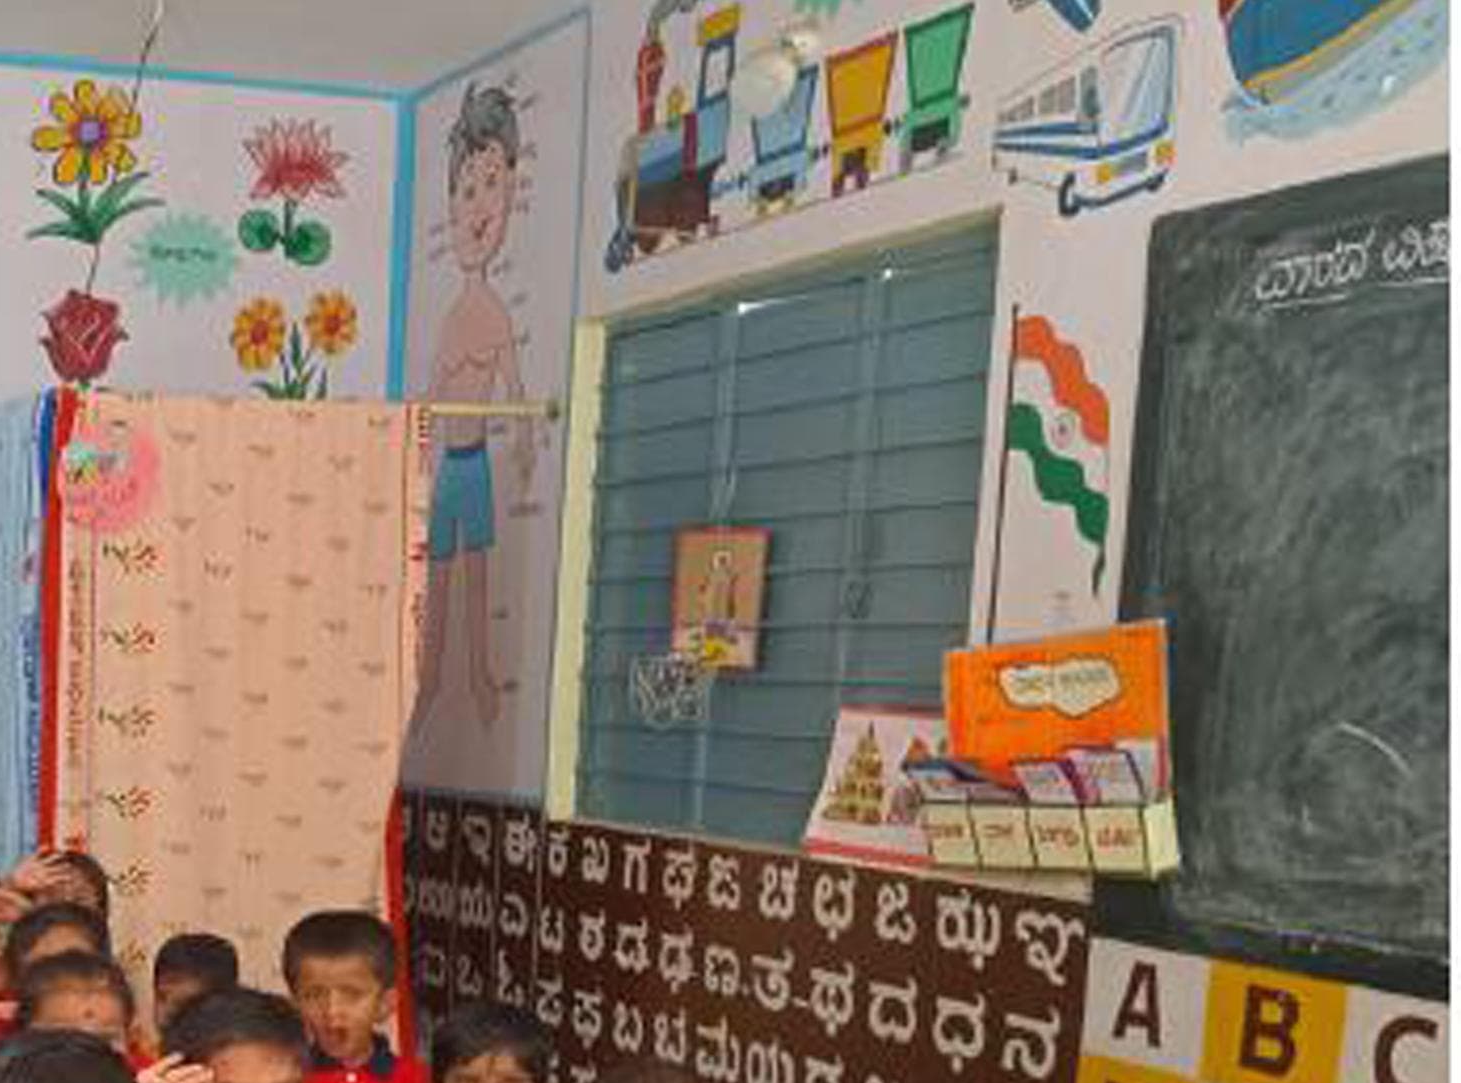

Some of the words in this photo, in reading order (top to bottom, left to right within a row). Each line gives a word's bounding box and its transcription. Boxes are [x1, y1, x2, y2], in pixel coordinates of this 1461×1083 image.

[547, 823, 571, 877] ಕ
[580, 834, 611, 886] ಖ
[623, 832, 650, 894] ಗ
[662, 841, 696, 903] ಘ
[757, 858, 798, 920] ಚ
[812, 865, 858, 942] ಛ
[874, 880, 917, 945] ಜ
[935, 887, 1002, 971] ಝ
[1014, 905, 1086, 986] ಞ
[539, 905, 564, 955] ಟ
[577, 911, 606, 962] ಠ
[612, 917, 648, 974] ಡ
[659, 923, 697, 994] ಢ
[703, 943, 741, 998] ಣ
[751, 935, 794, 1011] ತ
[809, 960, 856, 1037] ಥ
[868, 974, 917, 1045] ದ
[932, 990, 987, 1071] ಧ
[1003, 1006, 1062, 1081] ನ
[612, 1000, 643, 1053] ಬ
[695, 1015, 740, 1083] ಮ
[1112, 962, 1161, 1049] A
[1239, 983, 1302, 1078] B
